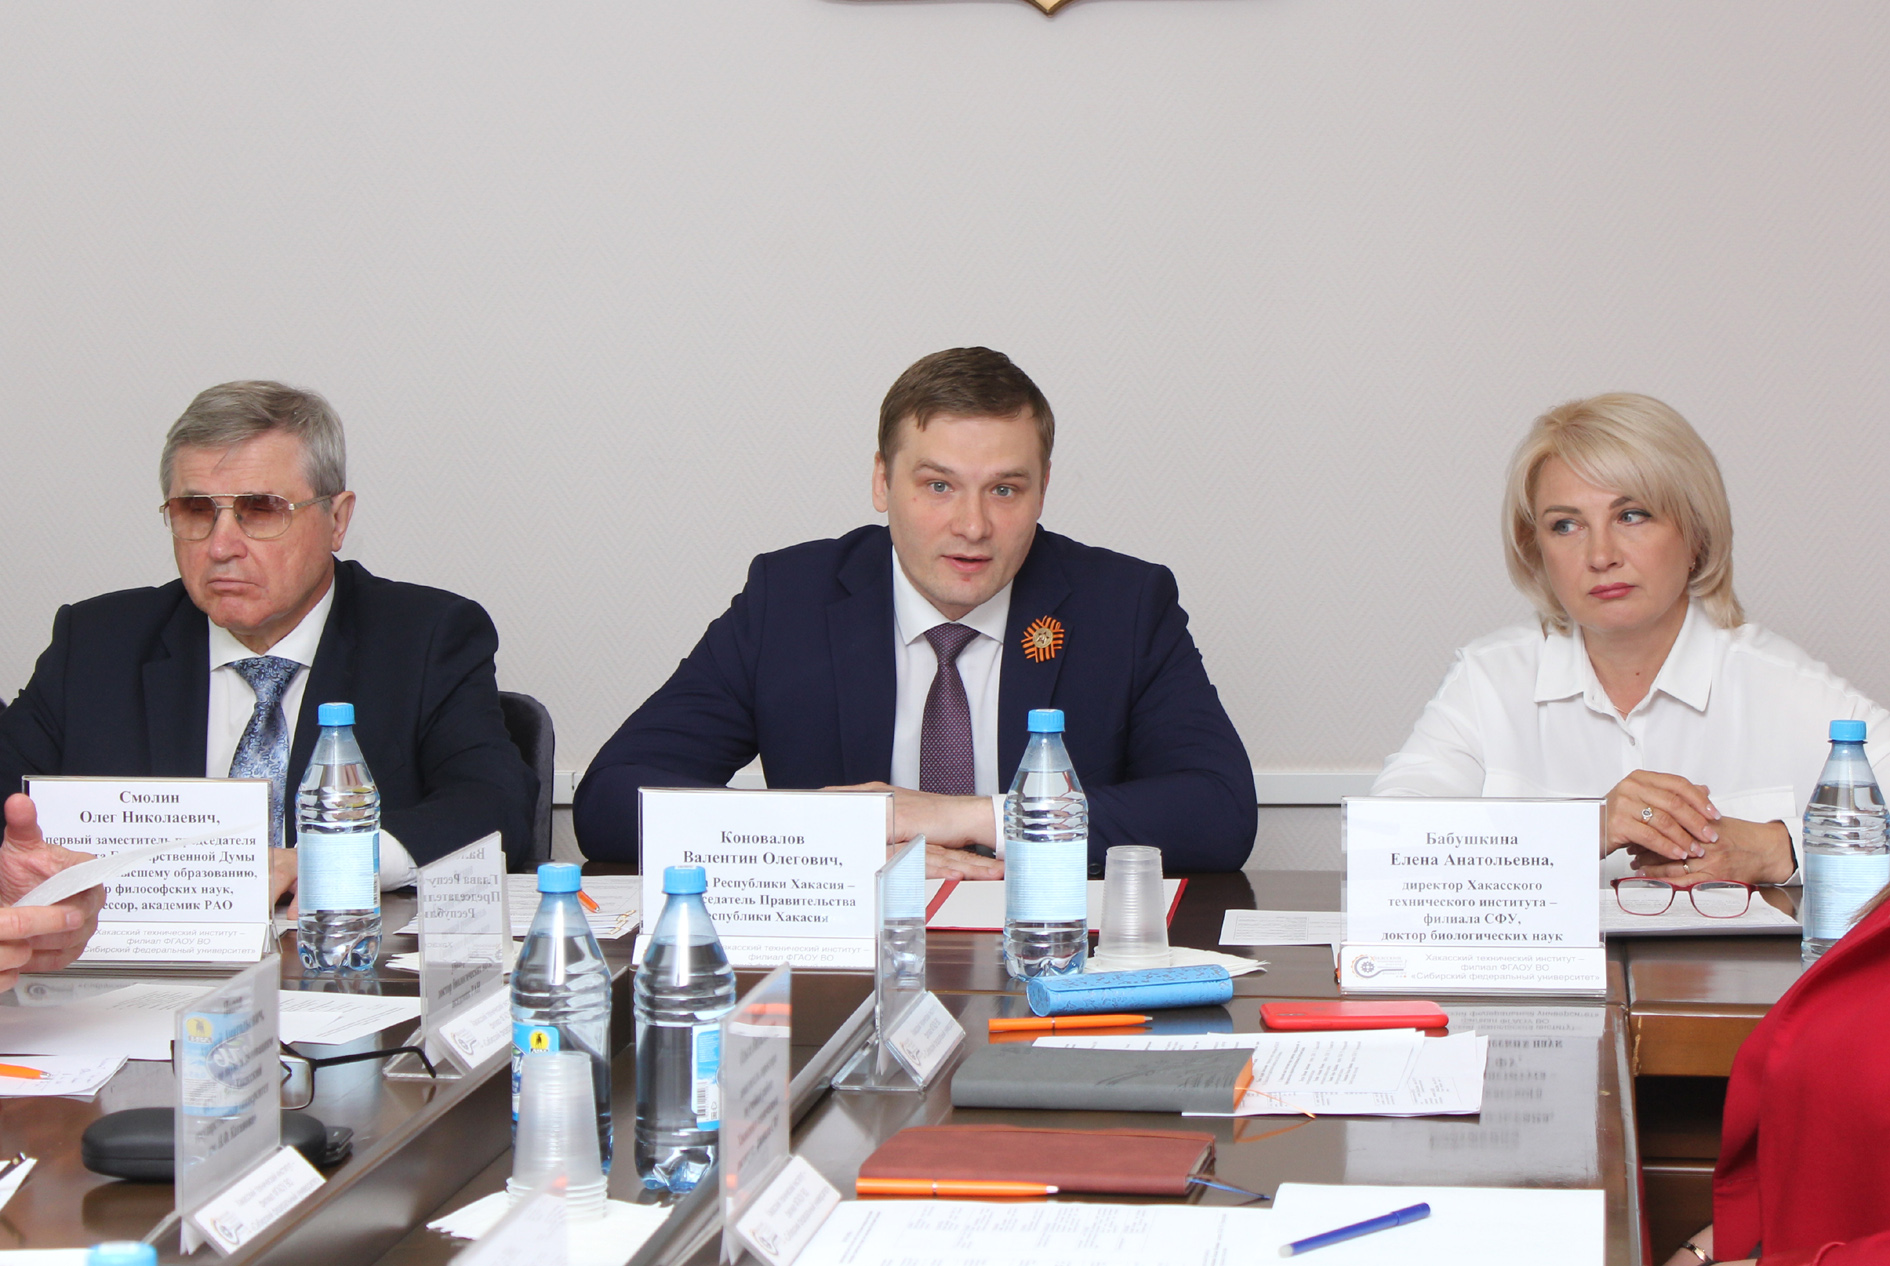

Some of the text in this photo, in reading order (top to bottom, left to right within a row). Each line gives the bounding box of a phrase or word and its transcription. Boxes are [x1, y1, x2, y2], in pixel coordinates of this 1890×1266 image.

[119, 790, 180, 804] Смолин
[79, 811, 221, 825] Олег Николаевич,
[45, 834, 92, 848] первый
[720, 831, 806, 845] Коновалов
[1426, 832, 1518, 848] Бабушкина
[218, 850, 255, 864] Думы
[683, 850, 843, 867] Валентин Олегович,
[1391, 853, 1554, 868] Елена Анатольевна,
[173, 867, 258, 880] образованию,
[115, 883, 234, 897] философских наук,
[712, 877, 786, 891] Республики
[790, 878, 845, 890] Хакасия
[1402, 880, 1542, 892] директор Хакасского
[141, 901, 200, 911] академик
[204, 899, 233, 910] РАО
[702, 894, 857, 908] седатель Правительства
[1388, 898, 1475, 908] технического
[1479, 898, 1546, 909] института
[709, 910, 829, 923] спублики Хакасия
[1423, 913, 1522, 927] филиала СФУ,
[143, 929, 197, 937] технический
[199, 930, 238, 938] институт
[1381, 929, 1563, 943] доктор биологических наук
[126, 937, 161, 946] филиал
[132, 946, 194, 956] федеральный
[764, 944, 820, 952] технический
[822, 947, 862, 955] институт
[748, 953, 784, 961] филиал
[786, 953, 819, 961] ФГАОУ
[1425, 953, 1472, 962] Хакасский
[1476, 954, 1532, 962] технический
[1535, 955, 1576, 964] институт
[1461, 963, 1550, 972] филиал ФГАОУ ВО
[1469, 972, 1534, 982] федеральный
[1537, 973, 1600, 982] университет»
